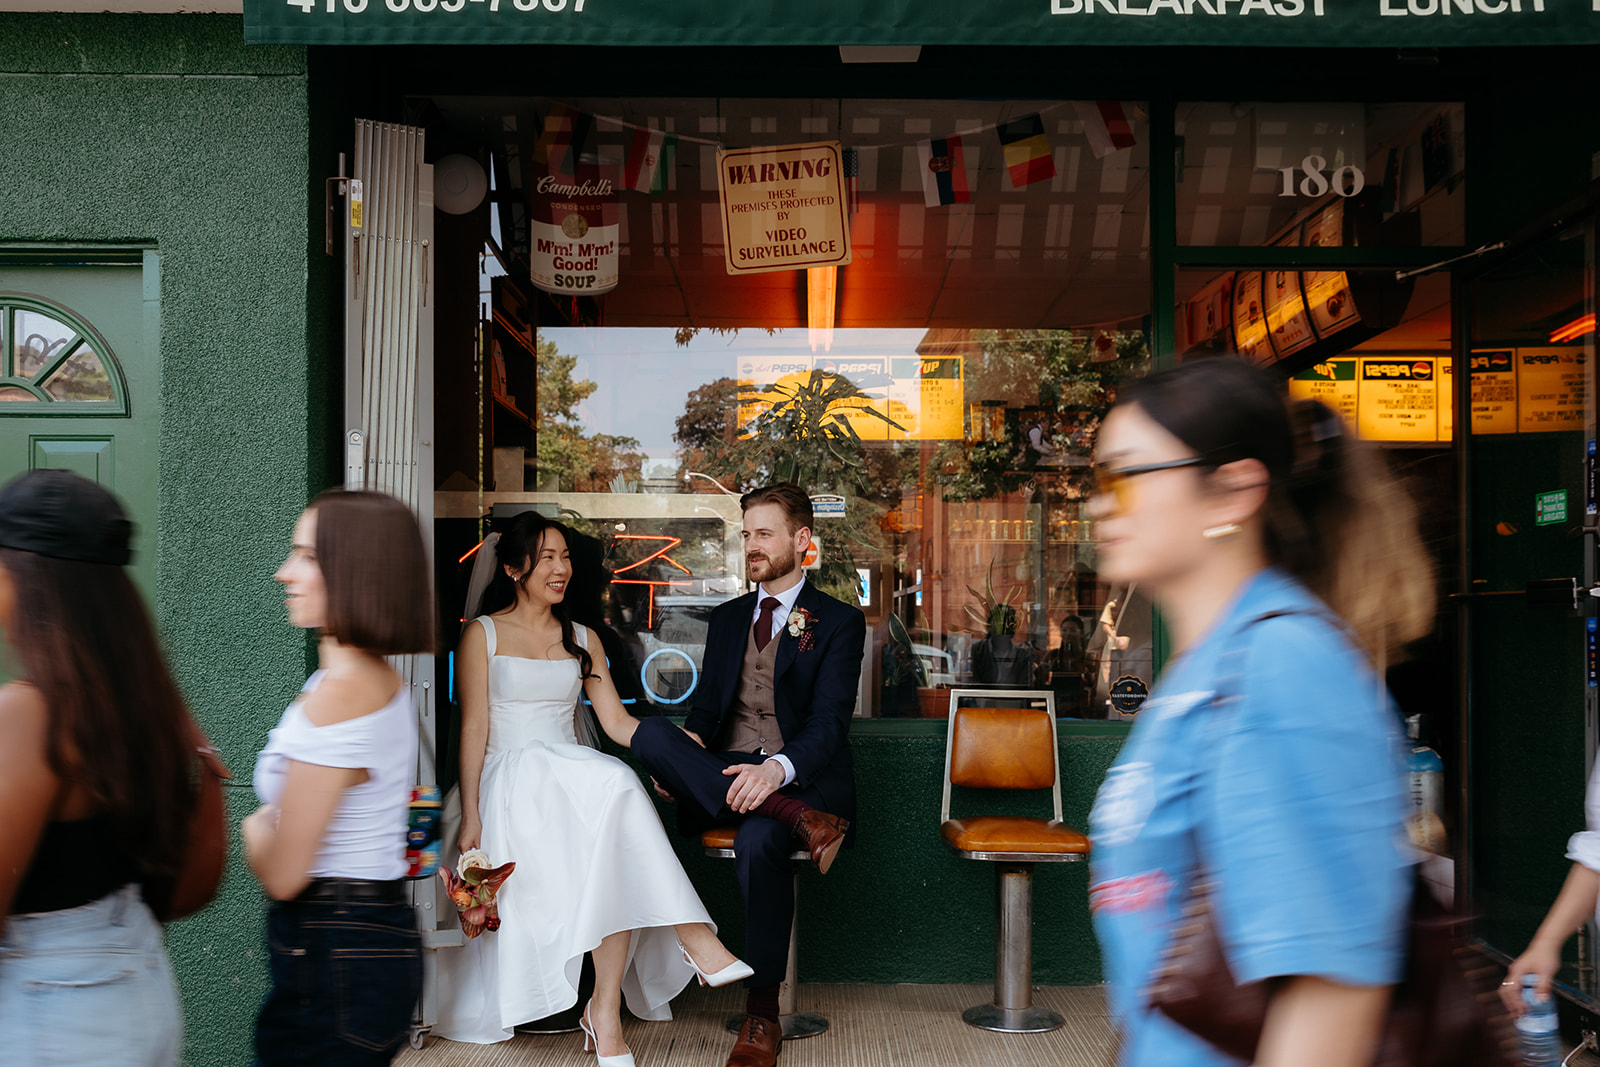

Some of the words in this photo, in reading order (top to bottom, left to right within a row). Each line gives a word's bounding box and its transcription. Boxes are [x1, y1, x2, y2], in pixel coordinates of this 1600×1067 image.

[728, 157, 830, 185] WARNING
[1278, 155, 1365, 198] 180
[536, 175, 613, 199] Campbell's
[768, 189, 796, 199] THESE
[550, 202, 602, 211] CONDENSED
[731, 201, 778, 213] PREMISES
[780, 196, 835, 209] PROTECTED
[777, 211, 790, 221] BY
[765, 227, 807, 242] VIDEO
[537, 238, 573, 257] M'm!
[578, 241, 614, 257] M'm!
[739, 240, 837, 261] SURVEILLANCE
[552, 256, 598, 271] Good!
[554, 273, 596, 288] SOUP
[771, 363, 808, 373] PEPSI
[838, 363, 882, 375] PEPSI
[913, 360, 940, 378] 7UP
